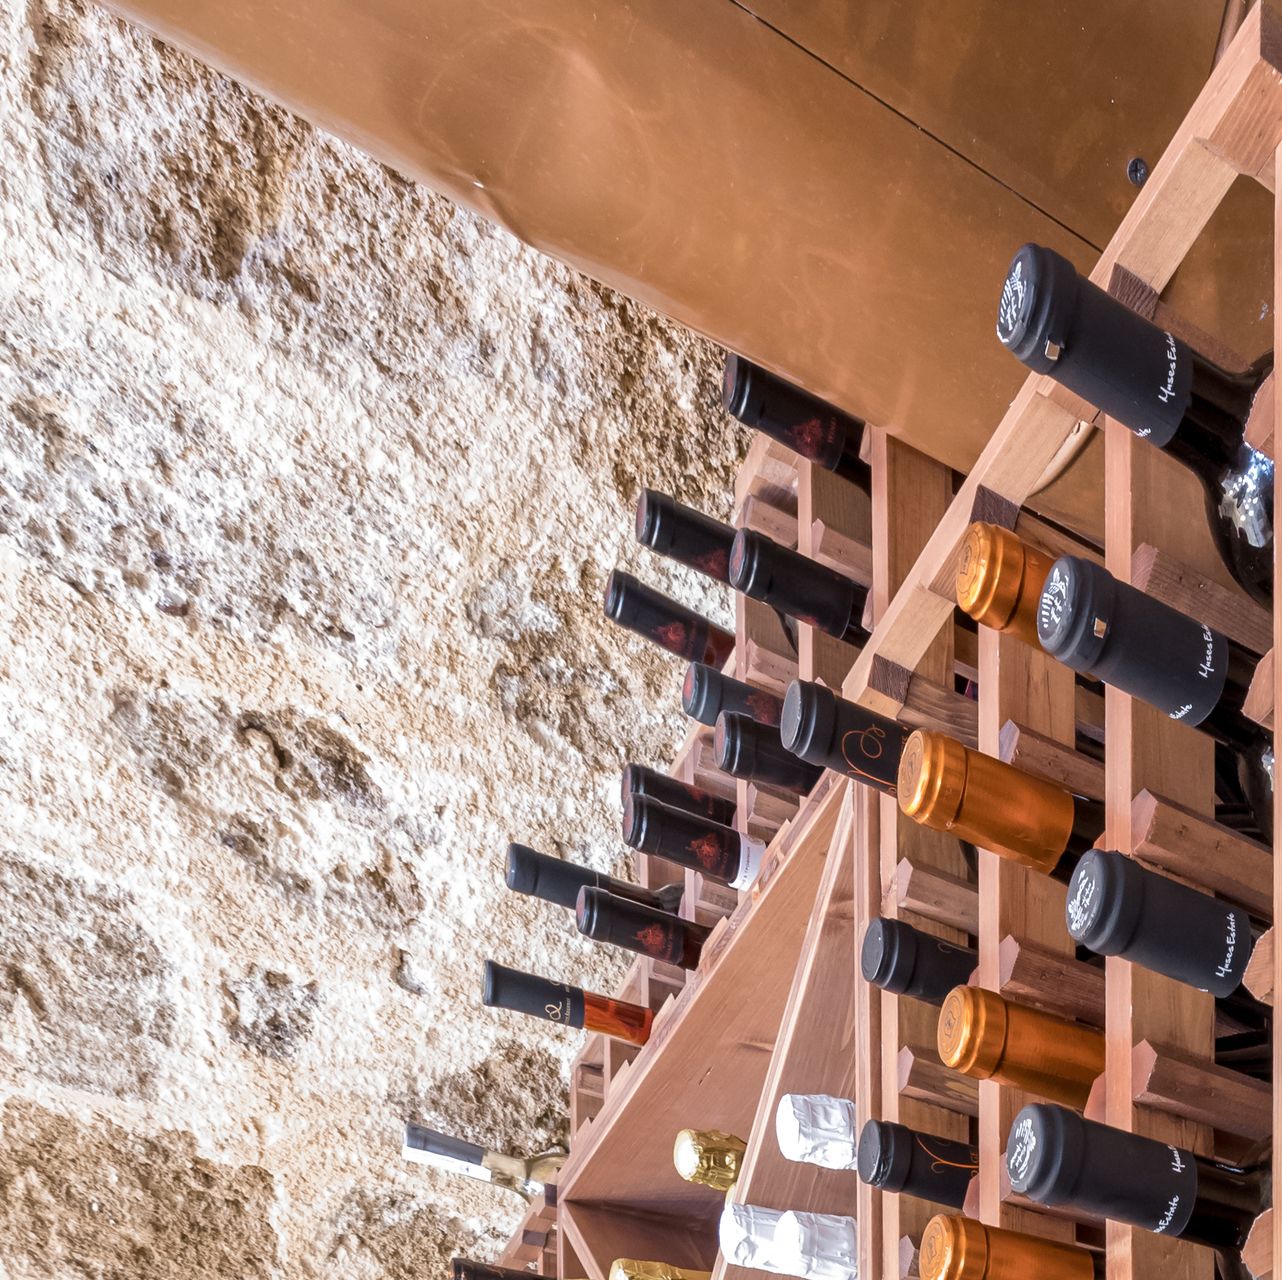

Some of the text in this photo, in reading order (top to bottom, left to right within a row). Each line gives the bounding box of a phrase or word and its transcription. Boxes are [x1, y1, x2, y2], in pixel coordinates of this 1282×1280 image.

[1198, 643, 1213, 679] Muses
[1214, 911, 1236, 978] Muses Estate
[1158, 1194, 1181, 1231] Estate
